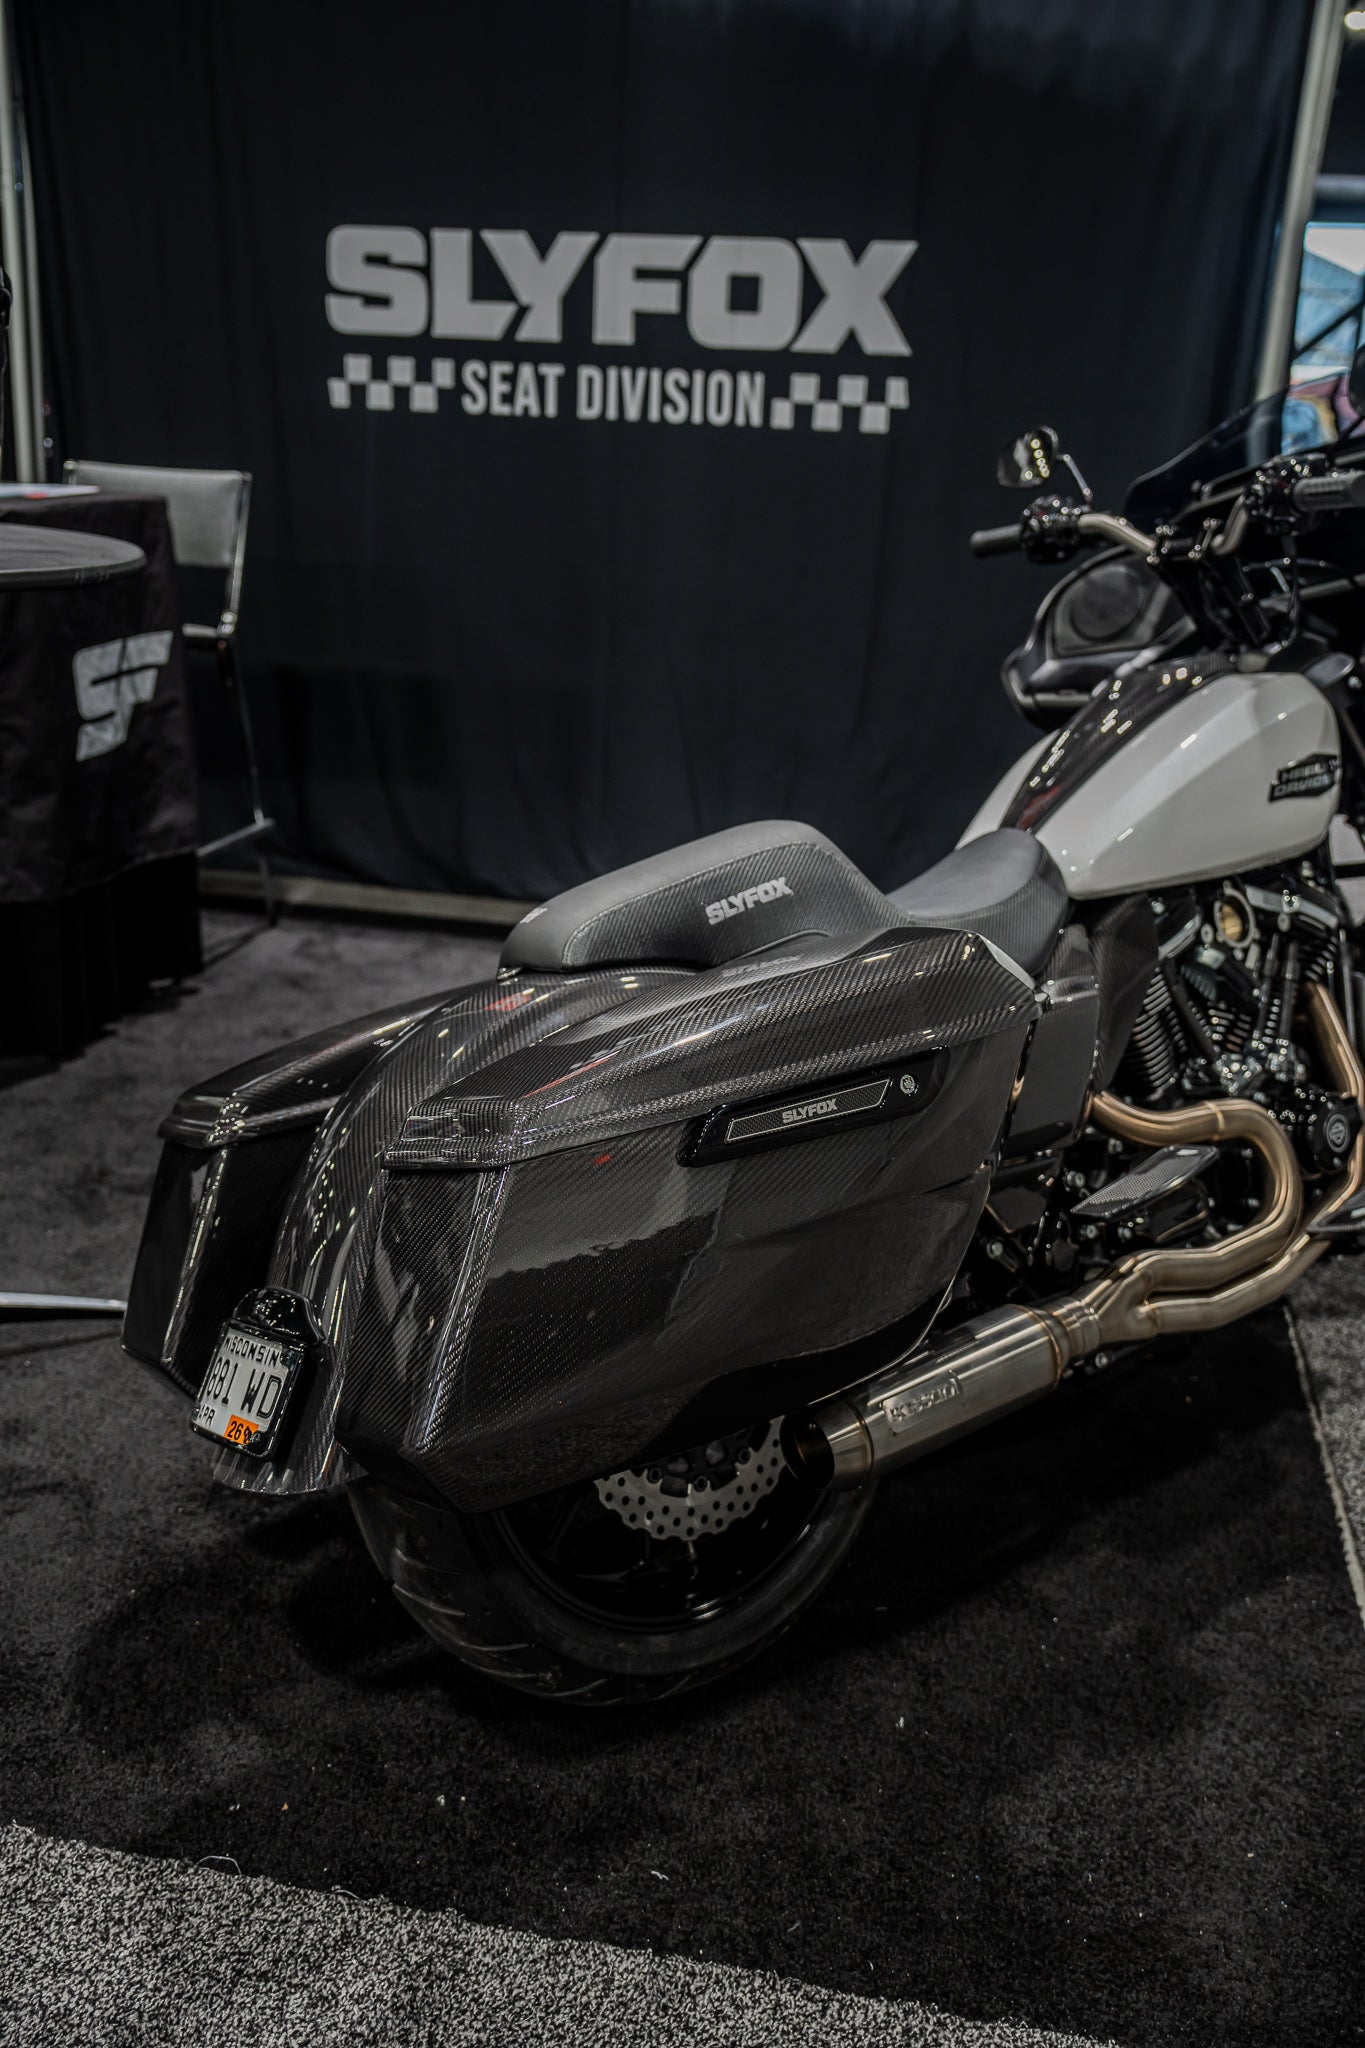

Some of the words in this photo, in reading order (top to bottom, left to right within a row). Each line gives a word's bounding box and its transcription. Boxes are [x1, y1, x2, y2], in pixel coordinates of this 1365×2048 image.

[325, 223, 919, 357] SLYFOX
[461, 359, 565, 418] SEAT
[576, 364, 765, 428] DIVISION
[705, 876, 794, 925] SLYFOX
[782, 1099, 838, 1124] SLYFOX
[206, 1357, 239, 1405] 881
[240, 1368, 283, 1419] WD
[227, 1420, 244, 1441] 26
